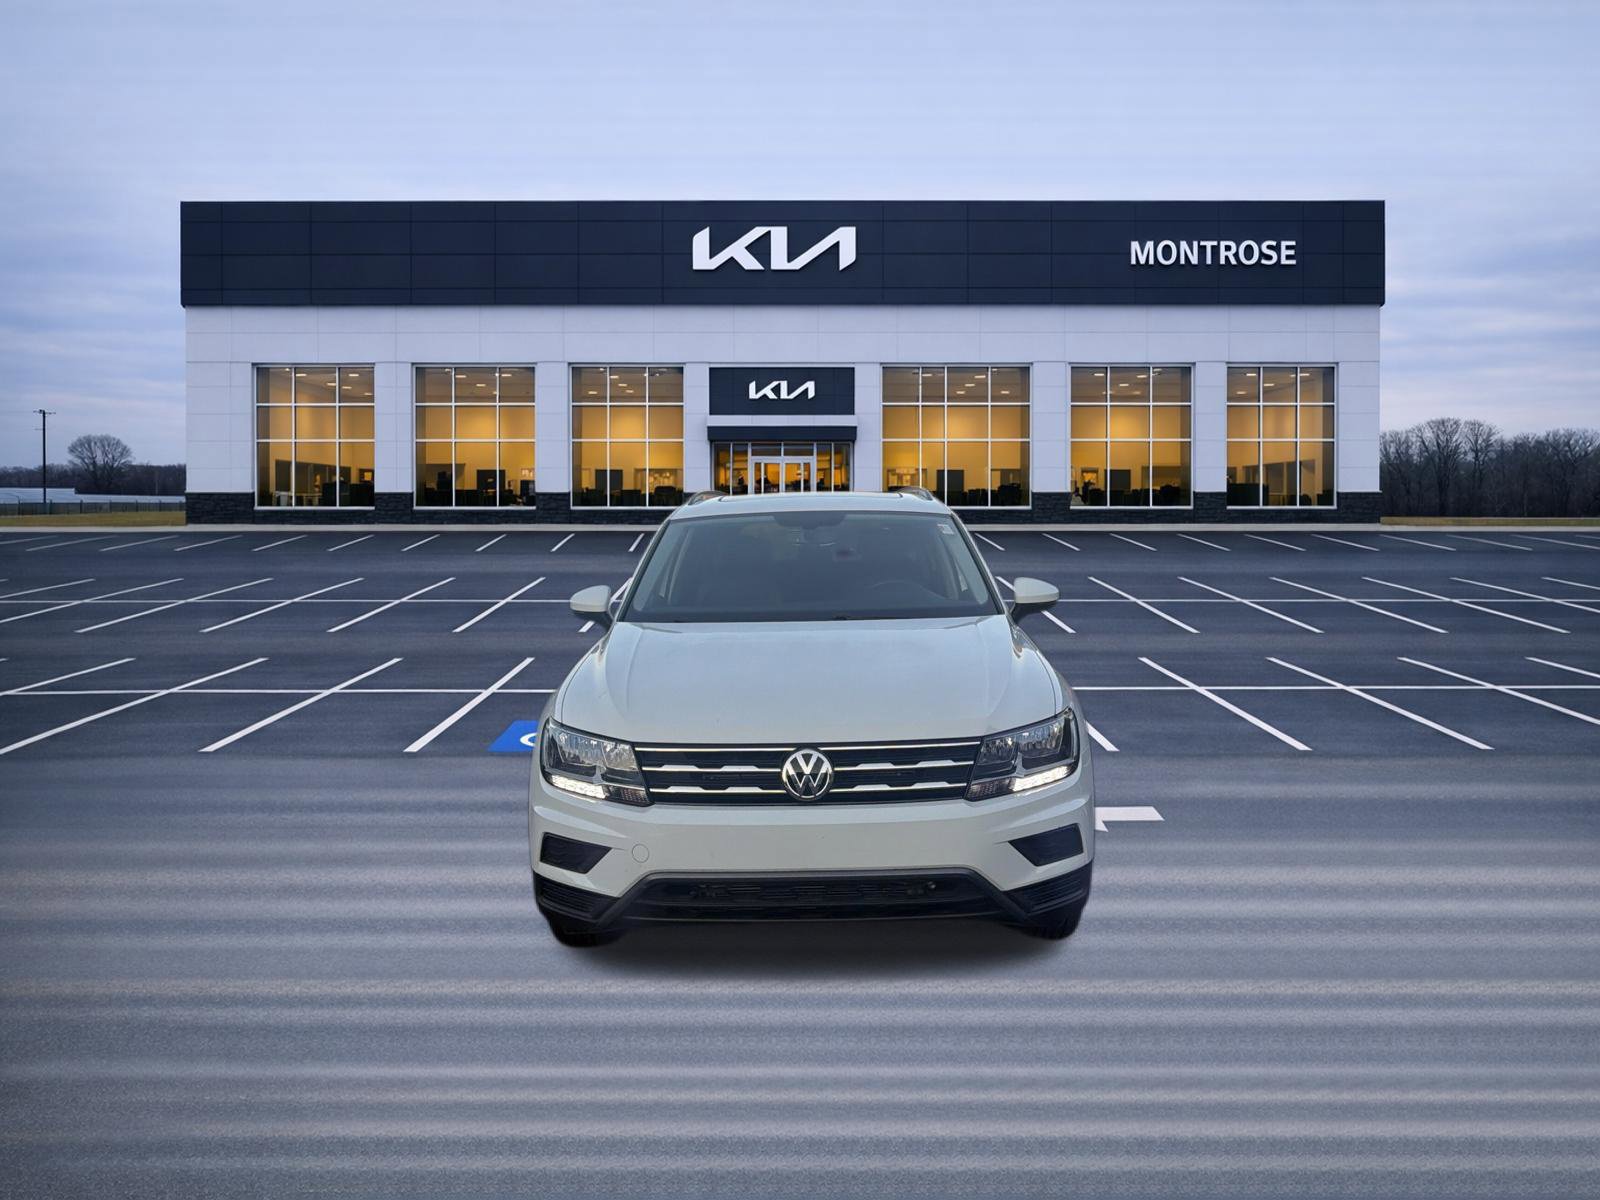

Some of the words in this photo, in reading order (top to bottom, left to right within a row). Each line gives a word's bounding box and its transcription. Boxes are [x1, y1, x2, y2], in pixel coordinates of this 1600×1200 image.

[692, 226, 857, 271] KIA
[1129, 239, 1297, 267] MONTROSE
[748, 380, 815, 400] KIA
